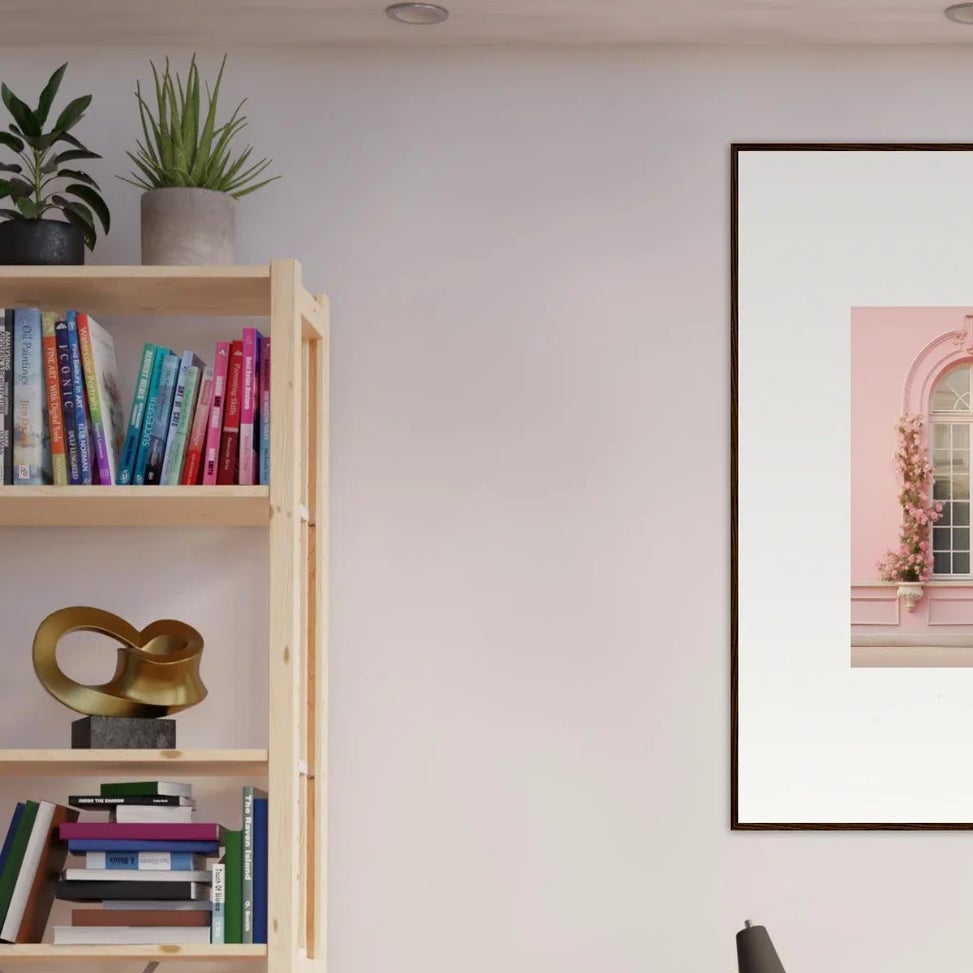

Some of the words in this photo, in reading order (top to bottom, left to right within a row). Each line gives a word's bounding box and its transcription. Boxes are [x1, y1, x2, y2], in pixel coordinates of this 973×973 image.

[22, 325, 33, 340] Oil
[18, 342, 33, 386] Paintings
[47, 347, 56, 364] FINE
[59, 344, 74, 410] ICONIC
[80, 326, 93, 373] Watercolor
[88, 375, 98, 412] Portraits
[230, 363, 241, 396] Parenting
[49, 384, 58, 402] With
[75, 394, 83, 408] ART
[50, 402, 60, 424] Digital
[229, 398, 238, 416] Skills
[52, 425, 62, 442] Tools
[142, 396, 157, 447] SUCCESSFUL
[79, 440, 89, 472] NORMAN
[244, 850, 252, 881] Island
